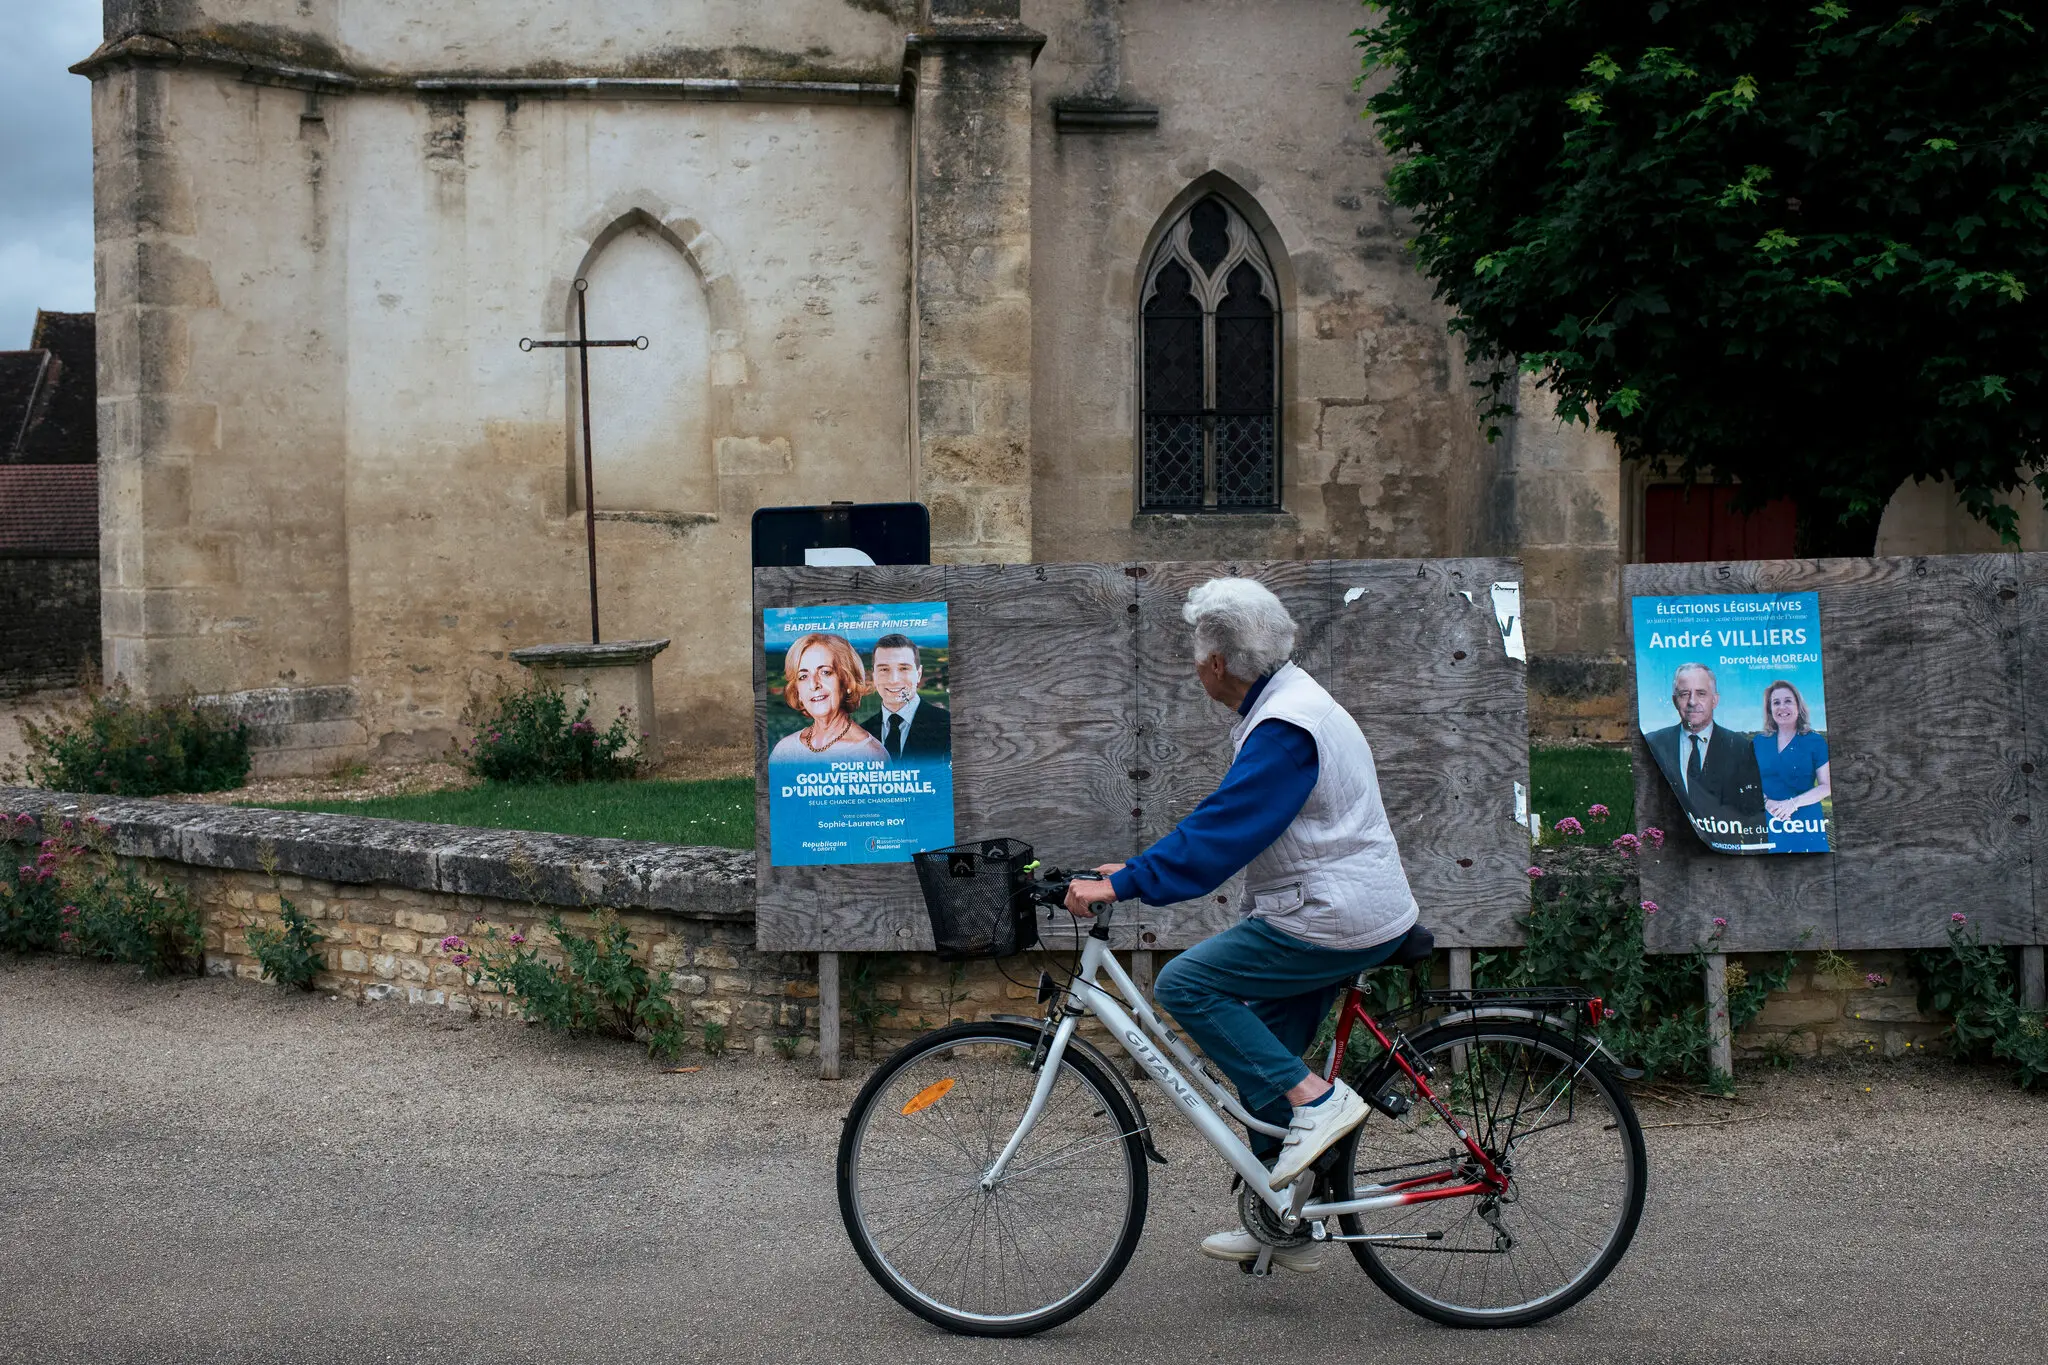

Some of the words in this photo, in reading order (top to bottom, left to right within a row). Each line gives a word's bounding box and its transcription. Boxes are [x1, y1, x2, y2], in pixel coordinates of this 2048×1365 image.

[1034, 566, 1048, 581] 2
[1416, 563, 1426, 578] 4
[1716, 566, 1731, 581] 5
[1656, 602, 1721, 615] ÉLECTIONS
[1723, 600, 1802, 613] LÉGISLATIVES
[783, 622, 836, 632] BARDELLA
[837, 620, 880, 631] PREMIER
[881, 618, 929, 629] MINISTRE
[1649, 630, 1713, 649] André
[1717, 628, 1807, 647] VILLIERS
[1719, 654, 1769, 665] Dorothée
[1771, 653, 1818, 664] MOREAU
[831, 762, 865, 772] POUR
[867, 761, 885, 771] UN
[796, 769, 921, 785] GOUVERNEMENT
[781, 784, 846, 798] D'UNION
[848, 781, 936, 796] NATIONALE,
[817, 820, 885, 830] Sophie-Laurence
[886, 818, 906, 826] ROY
[1743, 826, 1753, 835] et
[1756, 825, 1769, 834] du
[1768, 817, 1830, 834] Cœur
[876, 837, 919, 845] Rassemblement
[1711, 841, 1741, 851] HORIZONS
[1125, 1030, 1200, 1109] GITANE
